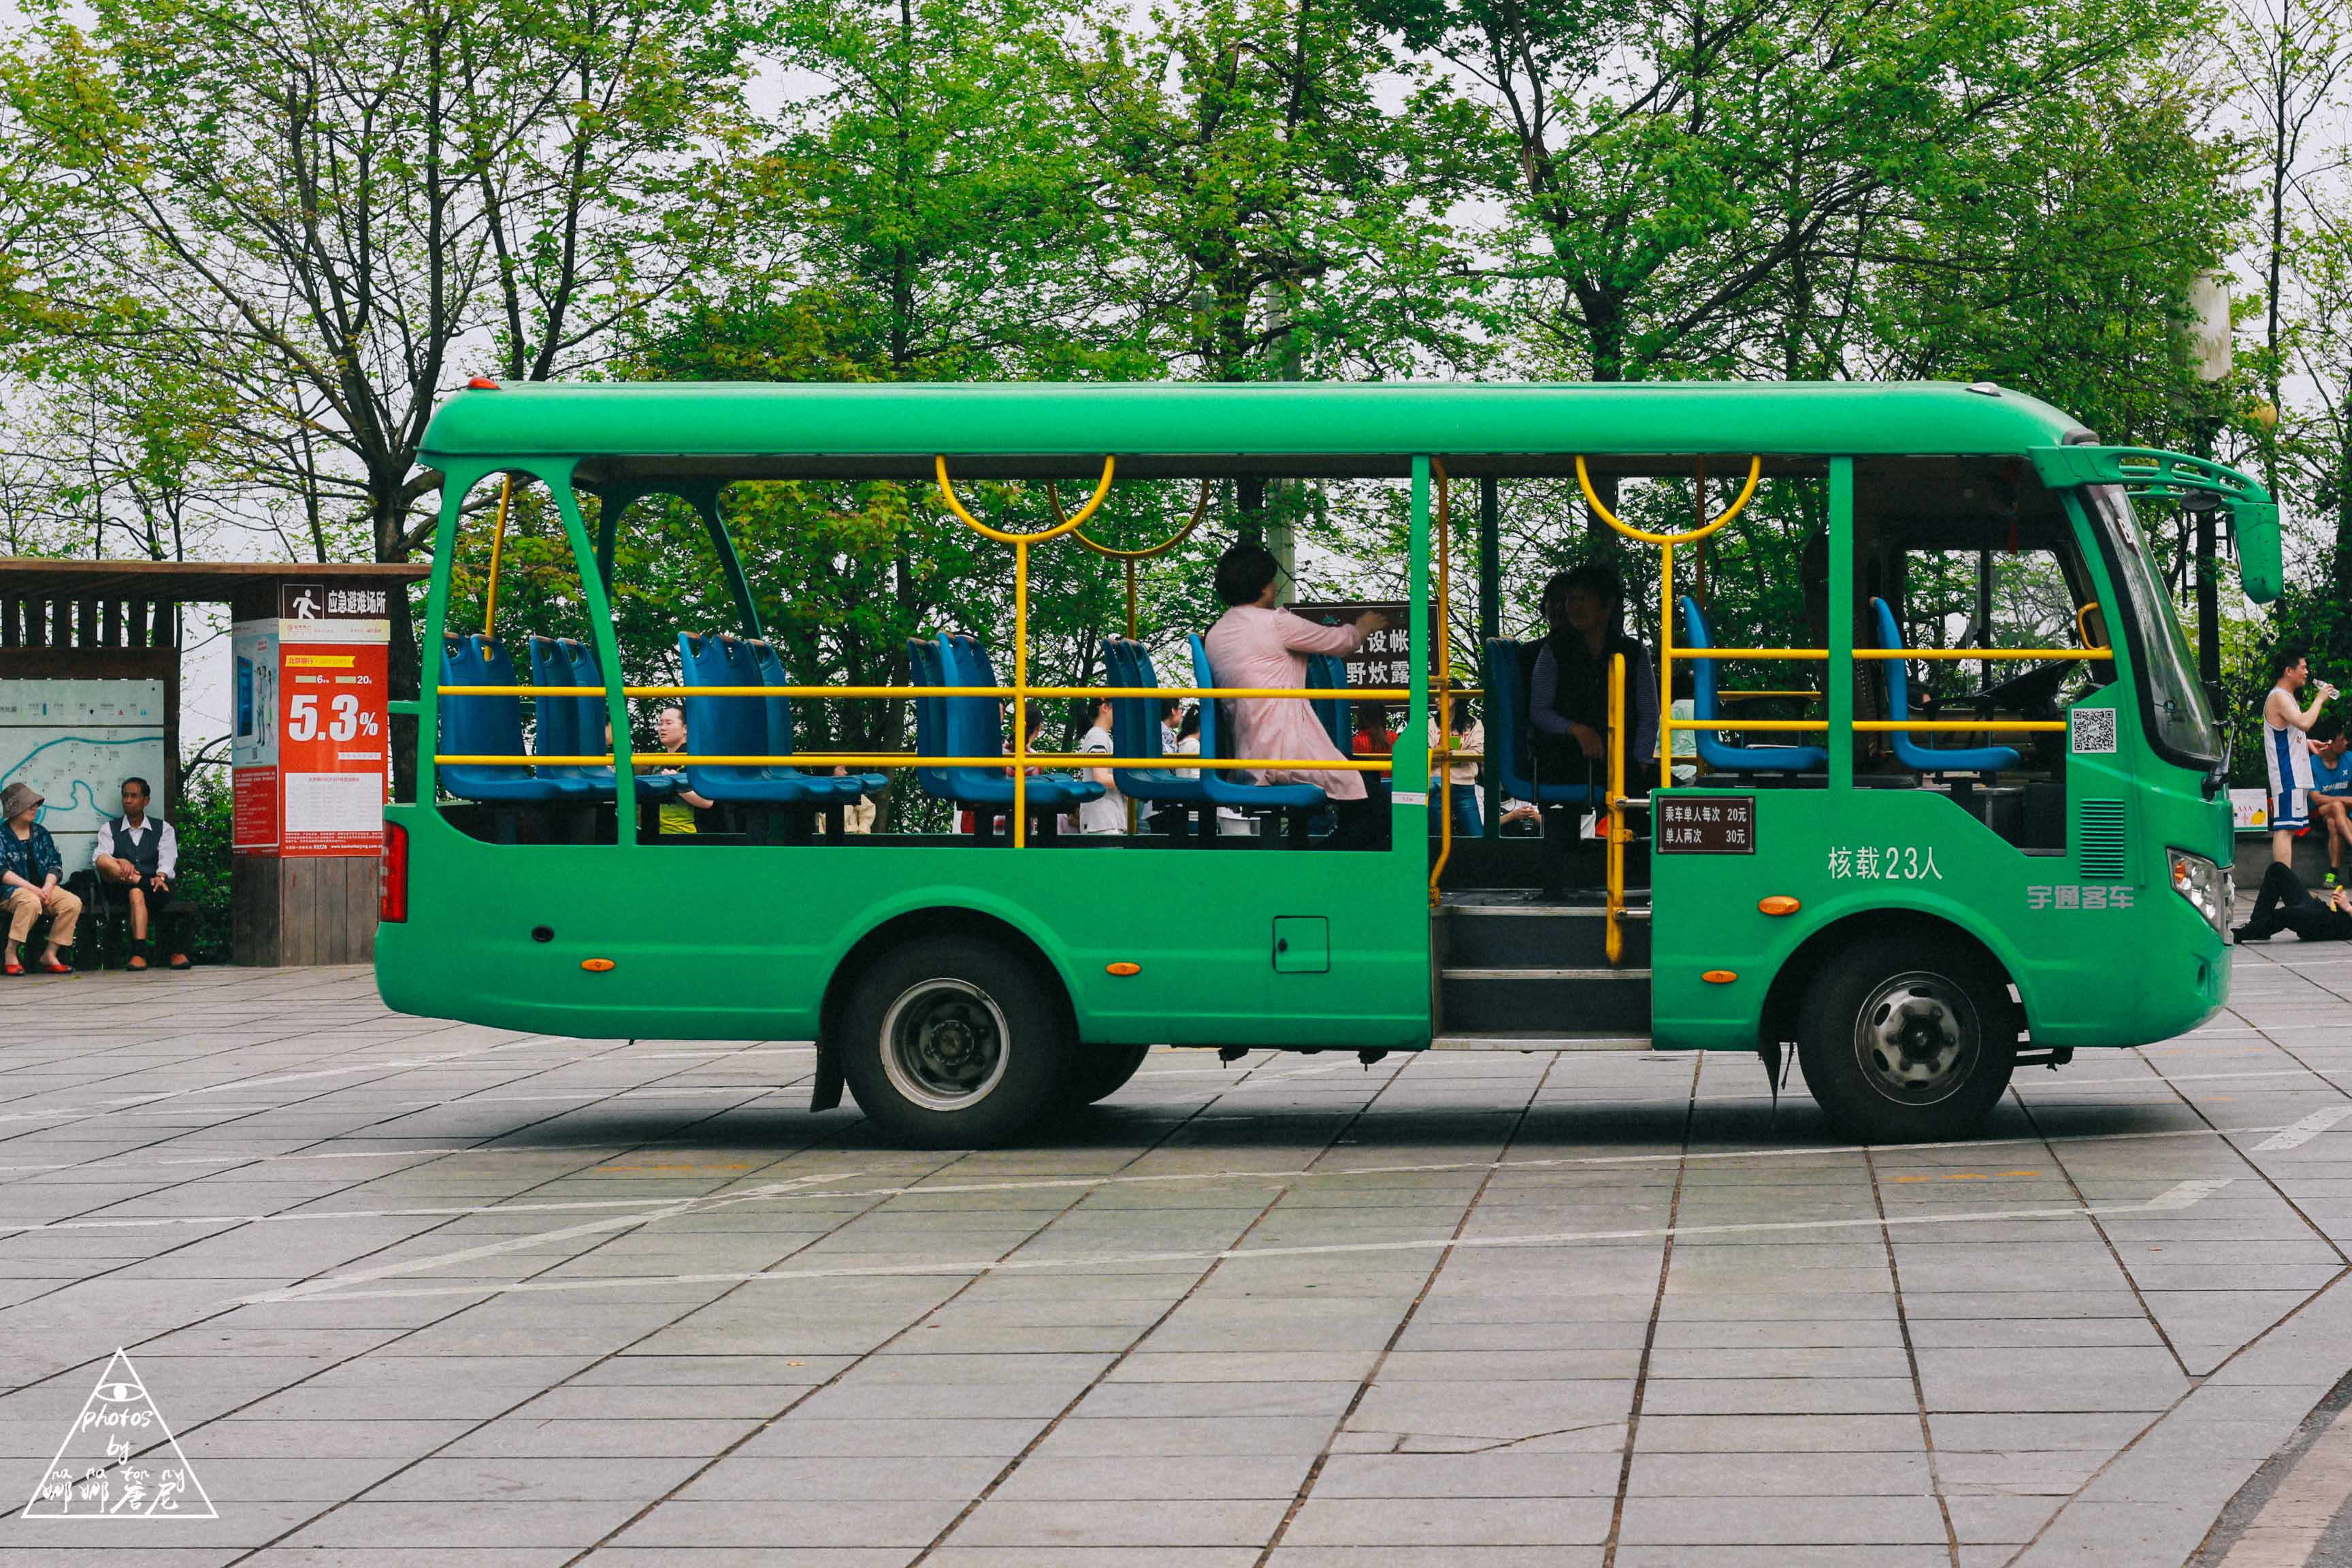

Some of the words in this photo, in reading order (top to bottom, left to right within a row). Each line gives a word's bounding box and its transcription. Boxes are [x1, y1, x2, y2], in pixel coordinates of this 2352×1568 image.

[328, 590, 386, 614] 应急避难场所
[1346, 660, 1432, 685] 野炊露
[289, 694, 378, 742] 5.3%
[1665, 806, 1720, 822] 乘车单人每次
[1727, 807, 1747, 822] 20元
[1665, 828, 1702, 844] 单人两次
[1726, 829, 1746, 844] 30元
[1828, 846, 1943, 880] 核载23人
[2027, 885, 2134, 909] 宇通客车
